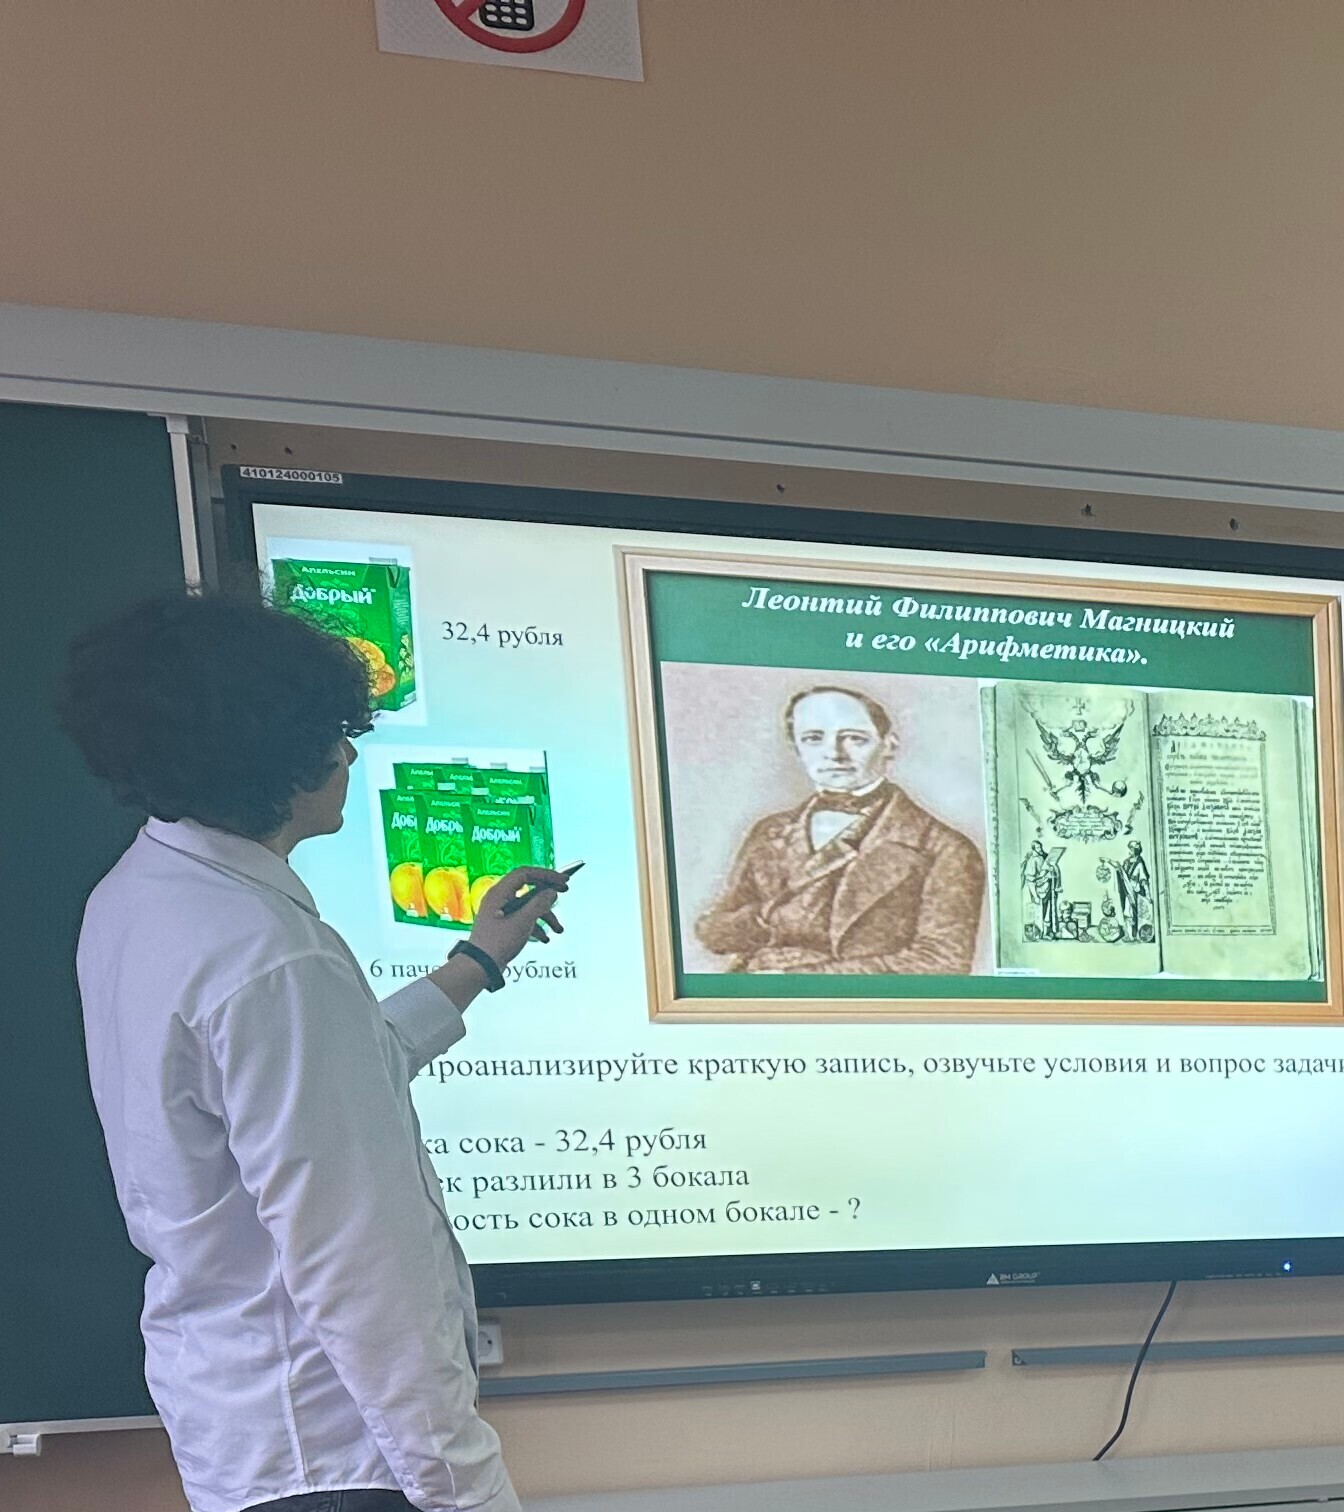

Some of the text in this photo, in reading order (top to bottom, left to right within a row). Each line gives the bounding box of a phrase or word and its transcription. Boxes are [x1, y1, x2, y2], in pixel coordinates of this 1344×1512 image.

[243, 468, 339, 482] 410124000105
[742, 587, 1236, 639] Леонтий Филиппович Магницкий
[442, 621, 563, 648] 32,4 рубля
[846, 632, 1148, 665] и его «Арифметика».
[371, 959, 382, 977] 6
[687, 1056, 806, 1081] краткую
[816, 1057, 914, 1077] запись,
[924, 1056, 1036, 1078] озвучьте
[1044, 1056, 1147, 1078] условия
[1156, 1058, 1170, 1073] и
[1180, 1057, 1266, 1078] вопрос
[459, 1136, 525, 1153] сока
[555, 1128, 615, 1155] 32,4
[625, 1127, 706, 1157] рубля
[472, 1172, 591, 1198] разлили
[603, 1172, 617, 1188] в
[627, 1166, 642, 1188] 3
[653, 1165, 750, 1188] бокала
[529, 1210, 593, 1228] сока
[604, 1210, 618, 1227] в
[628, 1207, 715, 1228] одном
[726, 1200, 820, 1223] бокале
[848, 1197, 860, 1220] ?
